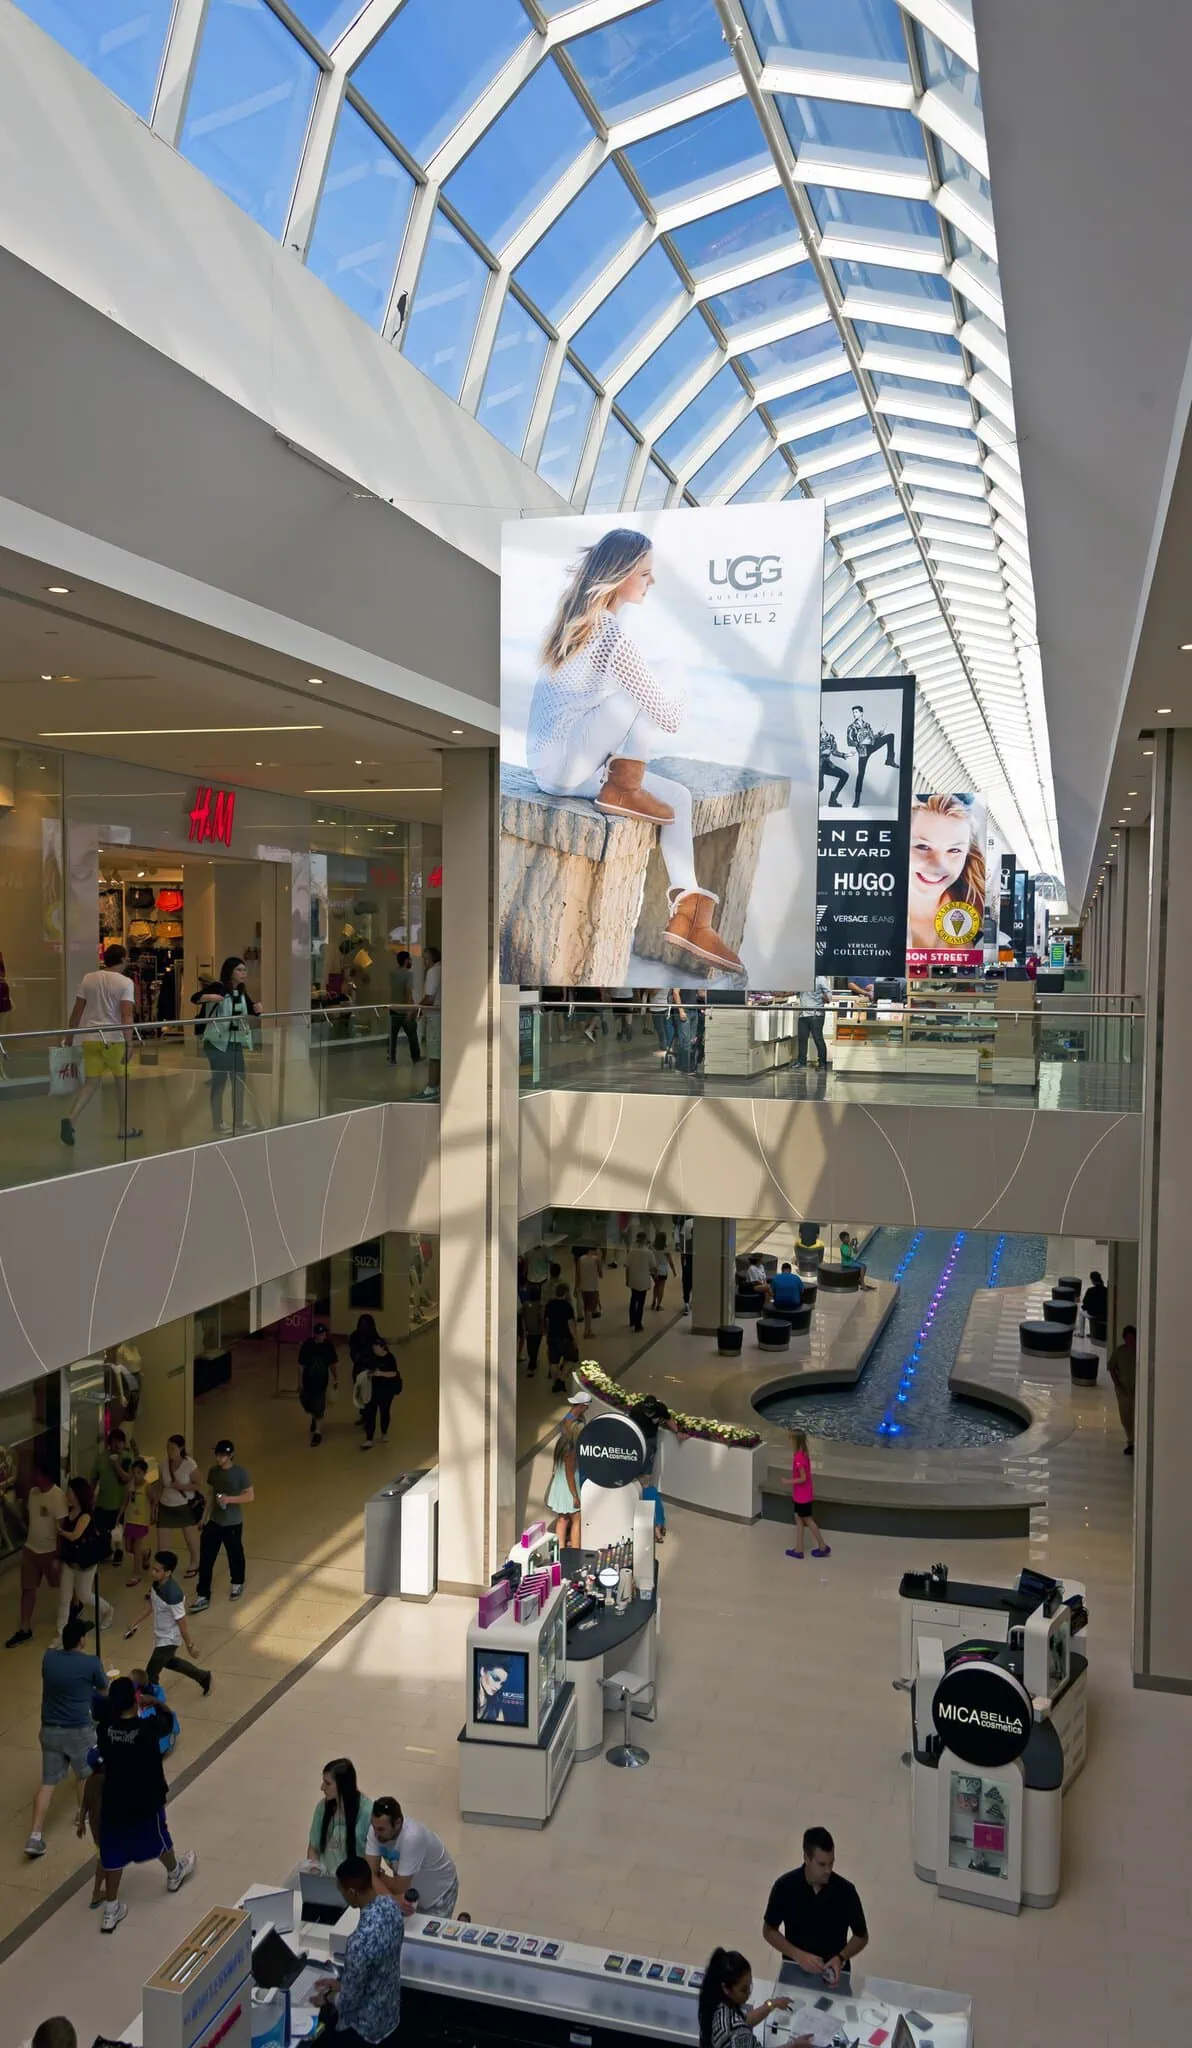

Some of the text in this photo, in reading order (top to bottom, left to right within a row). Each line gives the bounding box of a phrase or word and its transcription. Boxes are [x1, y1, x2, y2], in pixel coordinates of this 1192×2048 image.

[709, 555, 782, 591] UGG
[713, 611, 777, 625] LEVEL 2
[834, 872, 896, 891] HUGO
[833, 914, 896, 924] VERSACE JEANS
[833, 948, 892, 957] COLLECTION
[930, 953, 970, 962] STREET
[980, 1720, 1023, 1735] cosmetics
